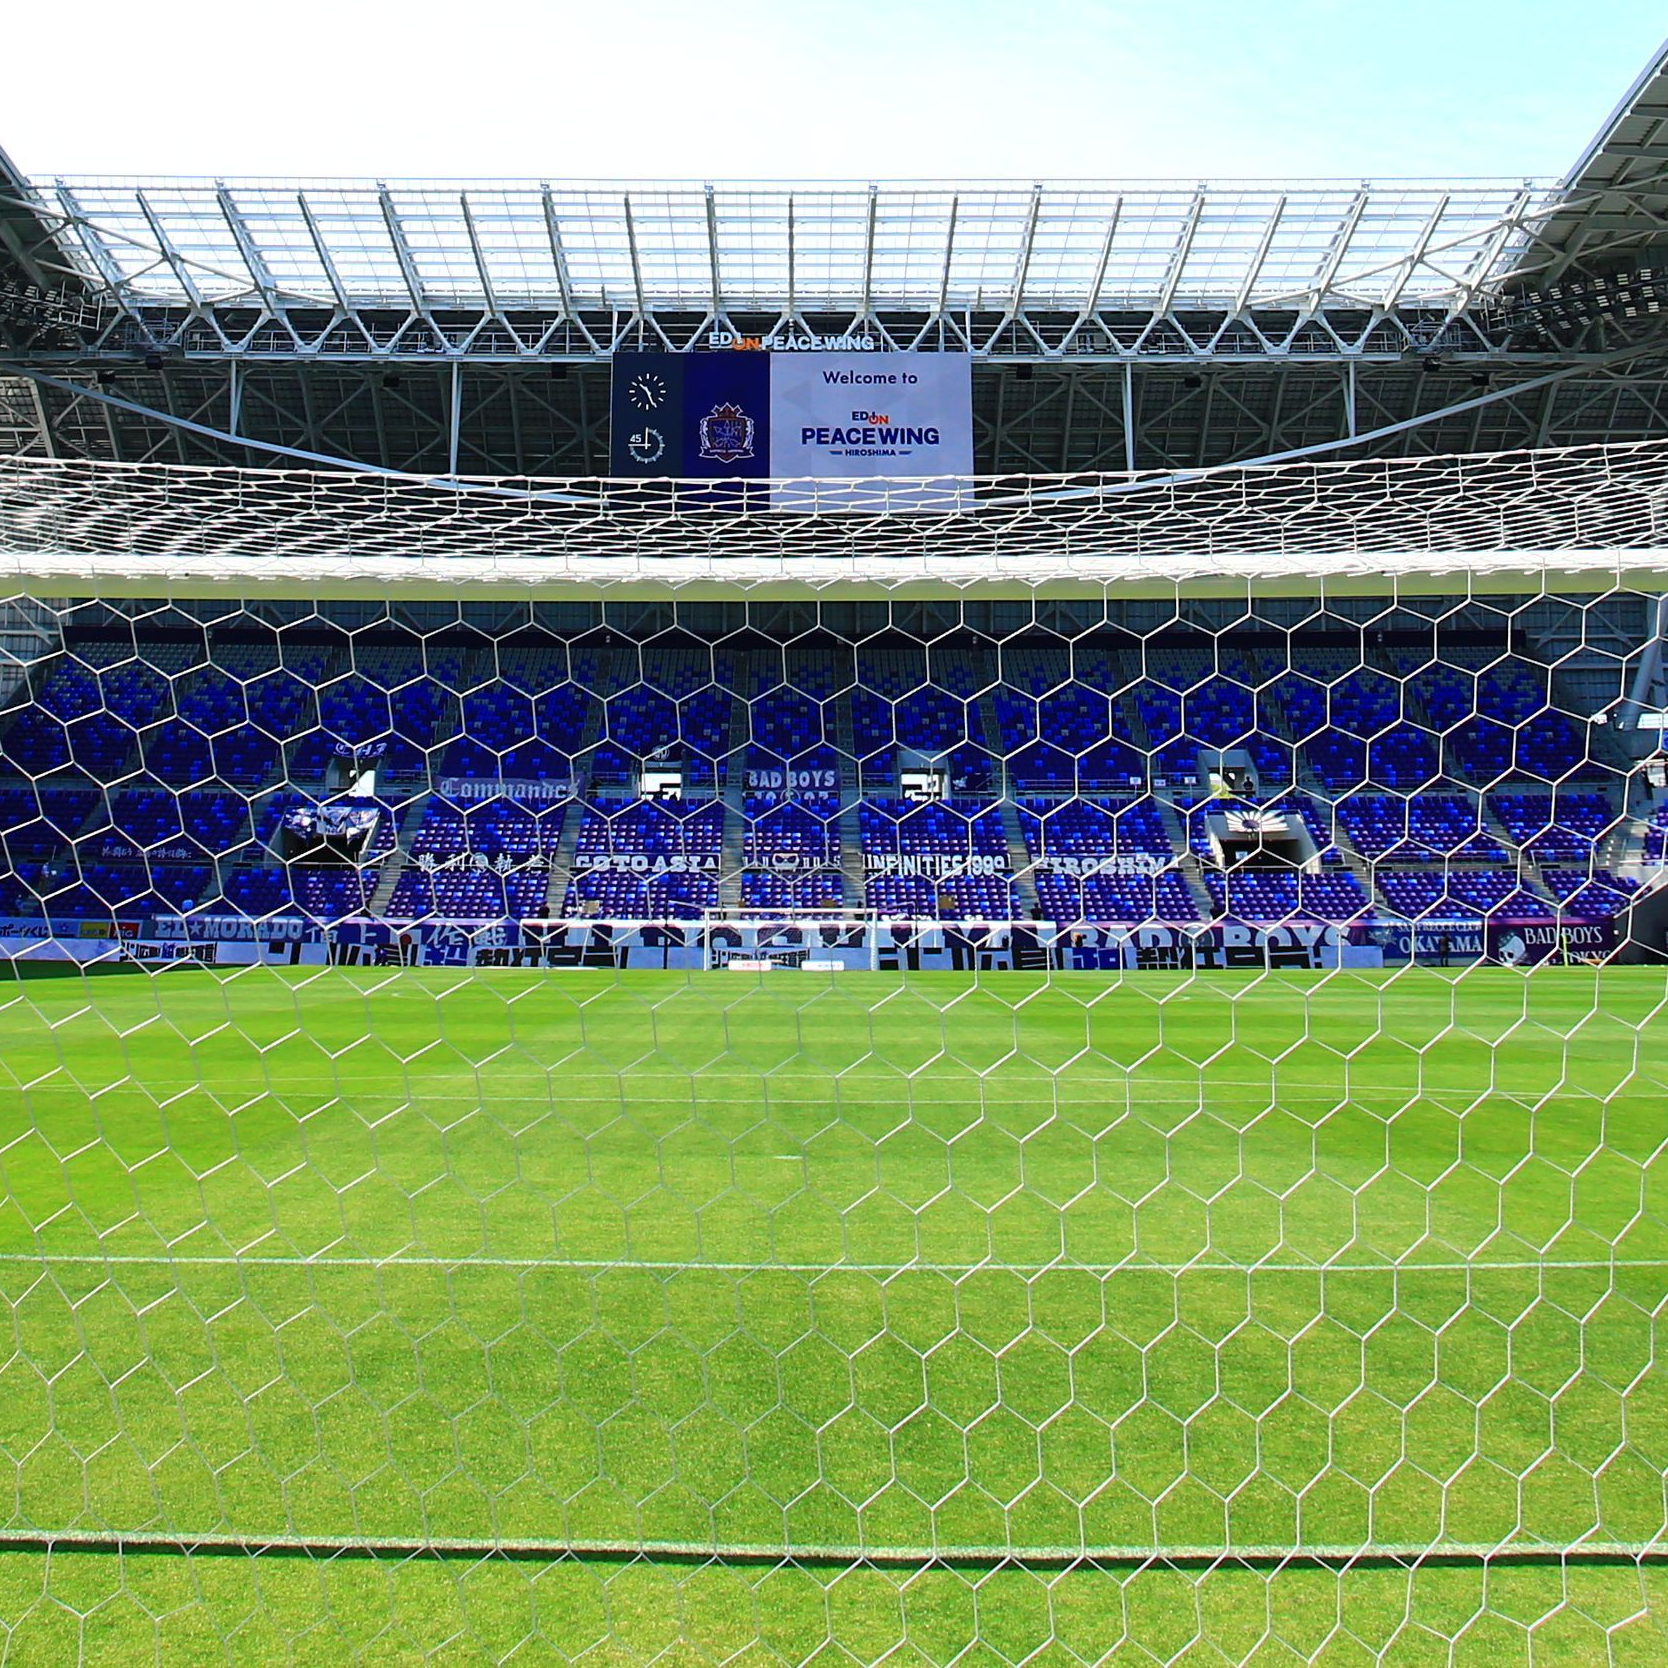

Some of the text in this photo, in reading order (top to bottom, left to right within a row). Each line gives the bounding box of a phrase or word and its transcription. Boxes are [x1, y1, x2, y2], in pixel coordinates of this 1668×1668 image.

[823, 370, 918, 386] Welcome to
[629, 433, 643, 444] 45
[845, 448, 897, 457] HIROSHIMA
[746, 770, 836, 788] BAD BOYS
[202, 917, 304, 940] MORADO
[1523, 926, 1603, 945] BAD BOYS
